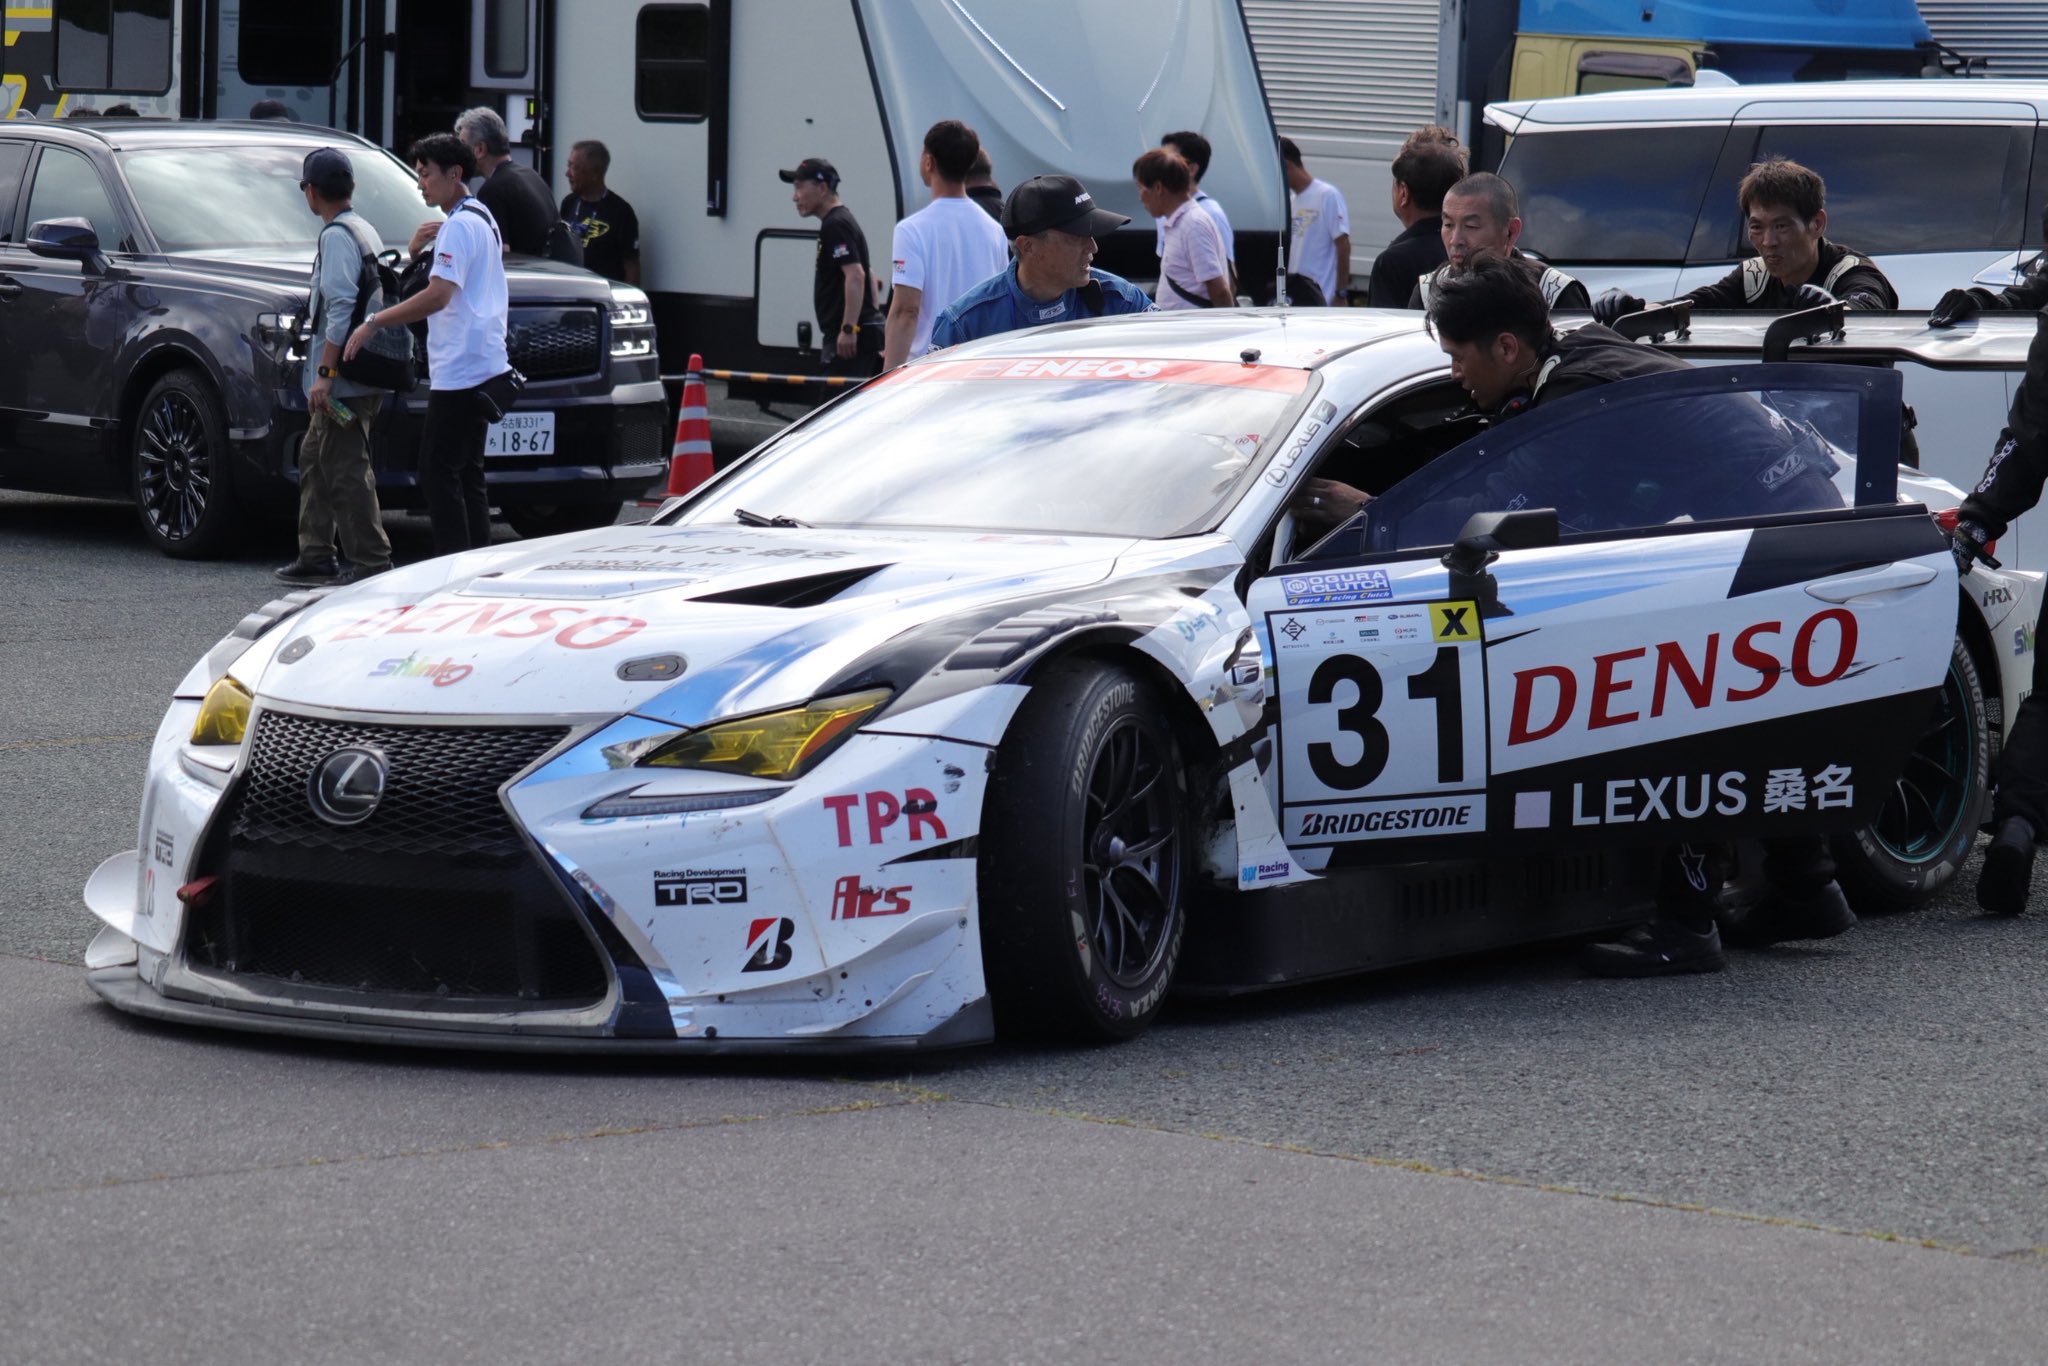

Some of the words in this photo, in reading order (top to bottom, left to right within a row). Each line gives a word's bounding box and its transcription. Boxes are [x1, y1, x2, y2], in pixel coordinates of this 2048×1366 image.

[1003, 359, 1167, 378] ENEOS
[523, 417, 539, 428] 331
[502, 431, 550, 453] 18-67
[1280, 422, 1321, 469] LEXUS
[572, 545, 756, 555] LEXUS
[1309, 571, 1385, 584] OGURA
[1311, 579, 1389, 593] CLUTCH
[328, 602, 648, 650] DENSO
[1440, 607, 1469, 637] X
[1507, 608, 1858, 746] DENSO
[1307, 646, 1463, 791] 31
[1572, 771, 1747, 826] LEXUS
[1763, 763, 1854, 813] 桑名
[823, 787, 948, 848] TPR
[1300, 806, 1471, 837] BRIDGESTONE
[654, 869, 685, 879] Racing
[686, 867, 746, 877] Development
[1259, 861, 1289, 874] Racing
[658, 881, 743, 907] TRD
